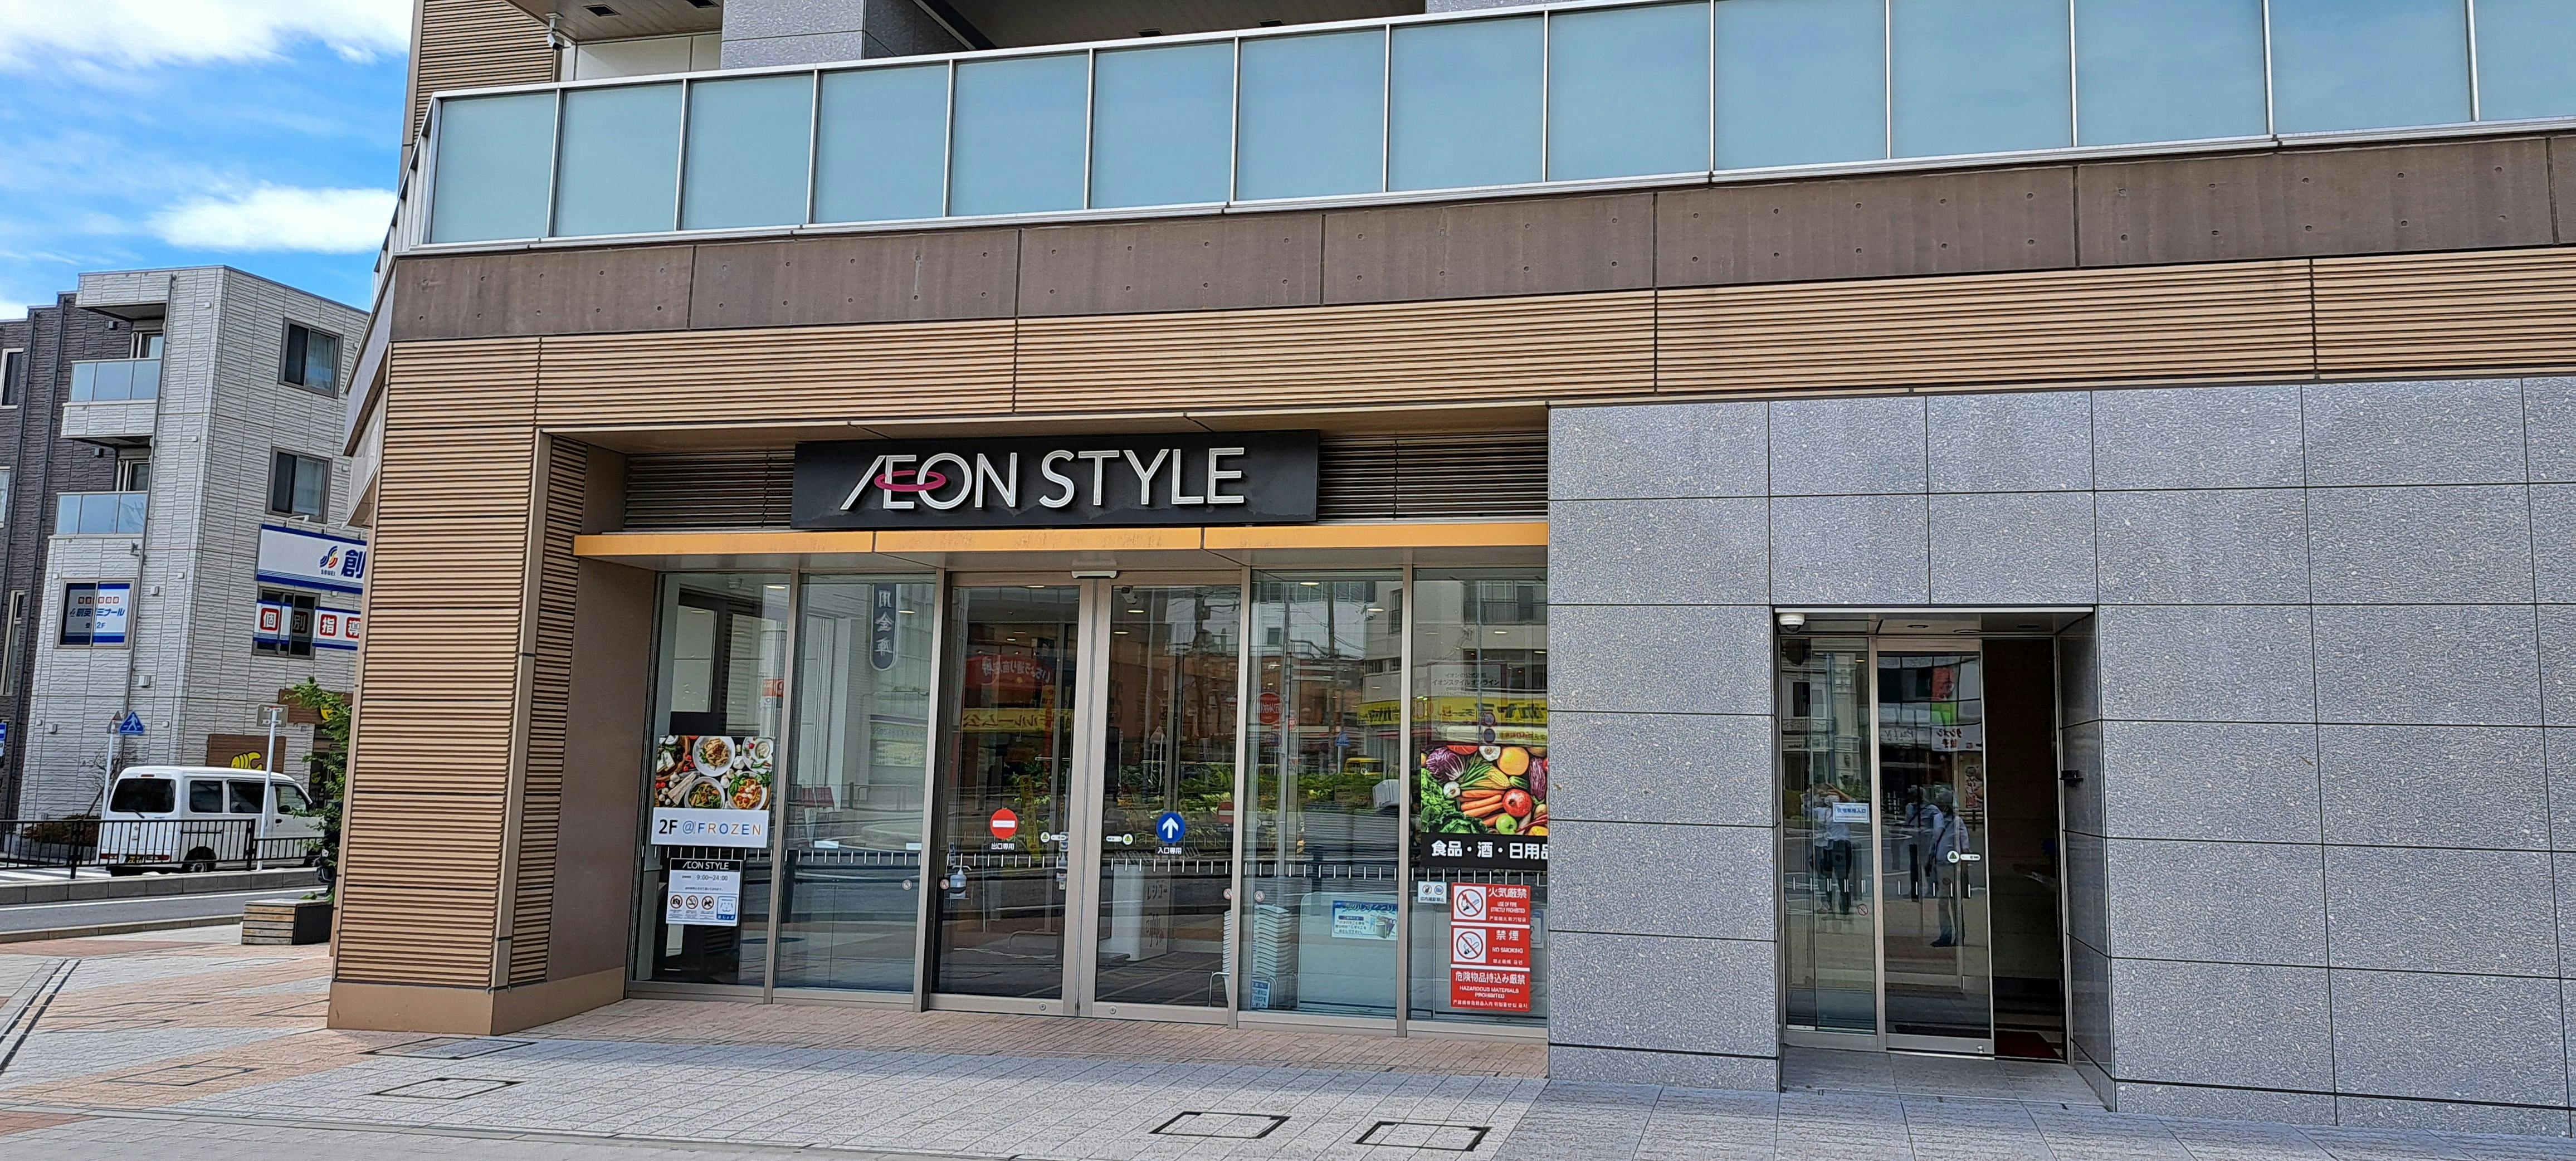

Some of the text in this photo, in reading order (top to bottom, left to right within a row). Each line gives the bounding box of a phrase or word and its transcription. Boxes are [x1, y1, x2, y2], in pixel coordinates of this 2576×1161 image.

[1040, 447, 1245, 508] STYLE
[658, 819, 678, 835] 2F
[1158, 846, 1182, 855] 入口専用
[1489, 886, 1527, 899] 火気厳禁
[1496, 930, 1519, 941] 禁煙
[1455, 971, 1525, 985] 危険物品持込み厳禁
